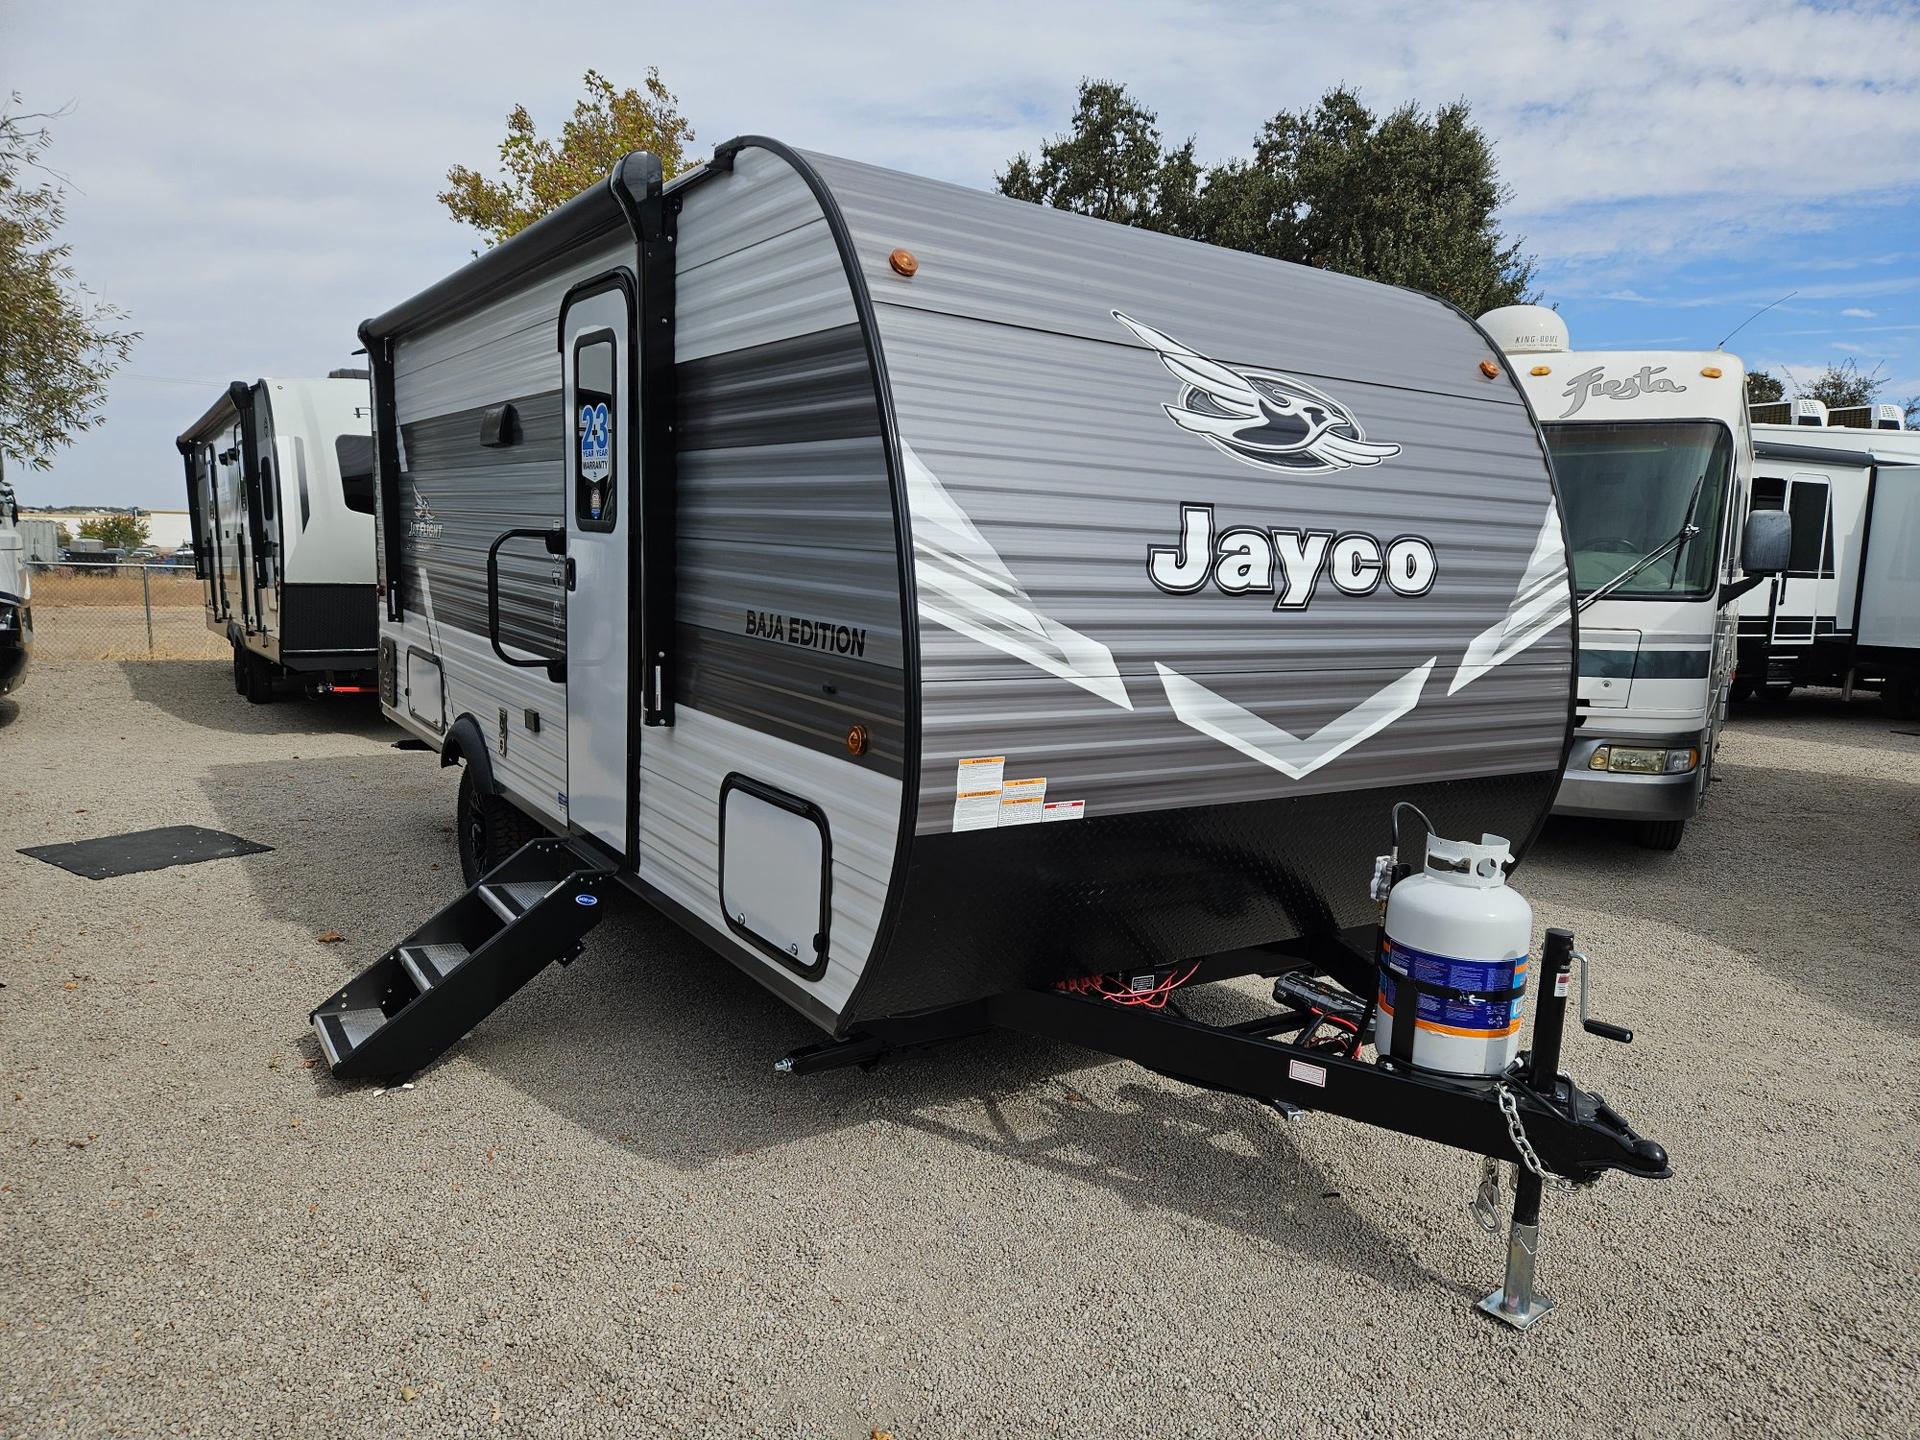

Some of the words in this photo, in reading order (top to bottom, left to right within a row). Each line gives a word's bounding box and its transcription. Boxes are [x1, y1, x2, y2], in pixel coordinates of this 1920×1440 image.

[1559, 366, 1687, 419] Fiesta
[583, 449, 594, 458] YEAR
[596, 448, 608, 457] YEAR
[583, 460, 608, 470] WARRANTY
[1146, 501, 1438, 612] Jayco
[745, 610, 784, 641] BAJA
[788, 617, 867, 657] EDITION
